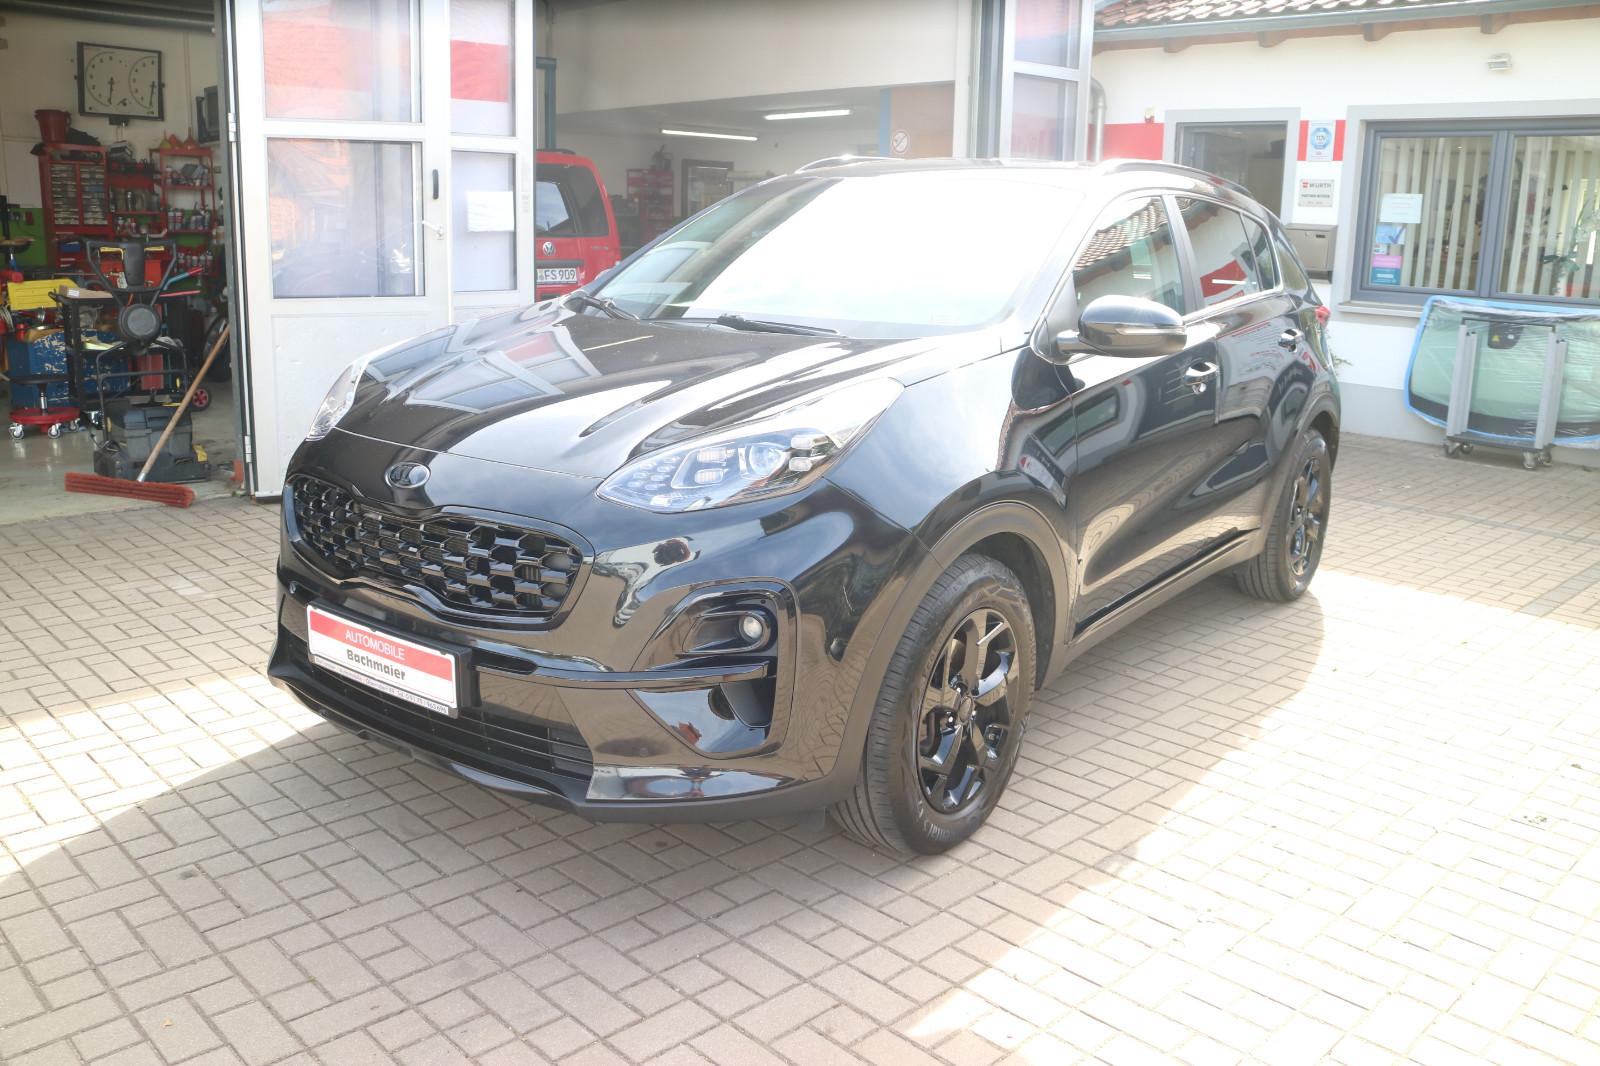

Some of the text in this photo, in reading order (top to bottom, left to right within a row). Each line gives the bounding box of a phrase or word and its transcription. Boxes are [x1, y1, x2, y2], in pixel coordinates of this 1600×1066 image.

[558, 269, 576, 280] 909
[345, 629, 405, 661] AUTOMOBILE
[346, 649, 406, 680] Bachmaier
